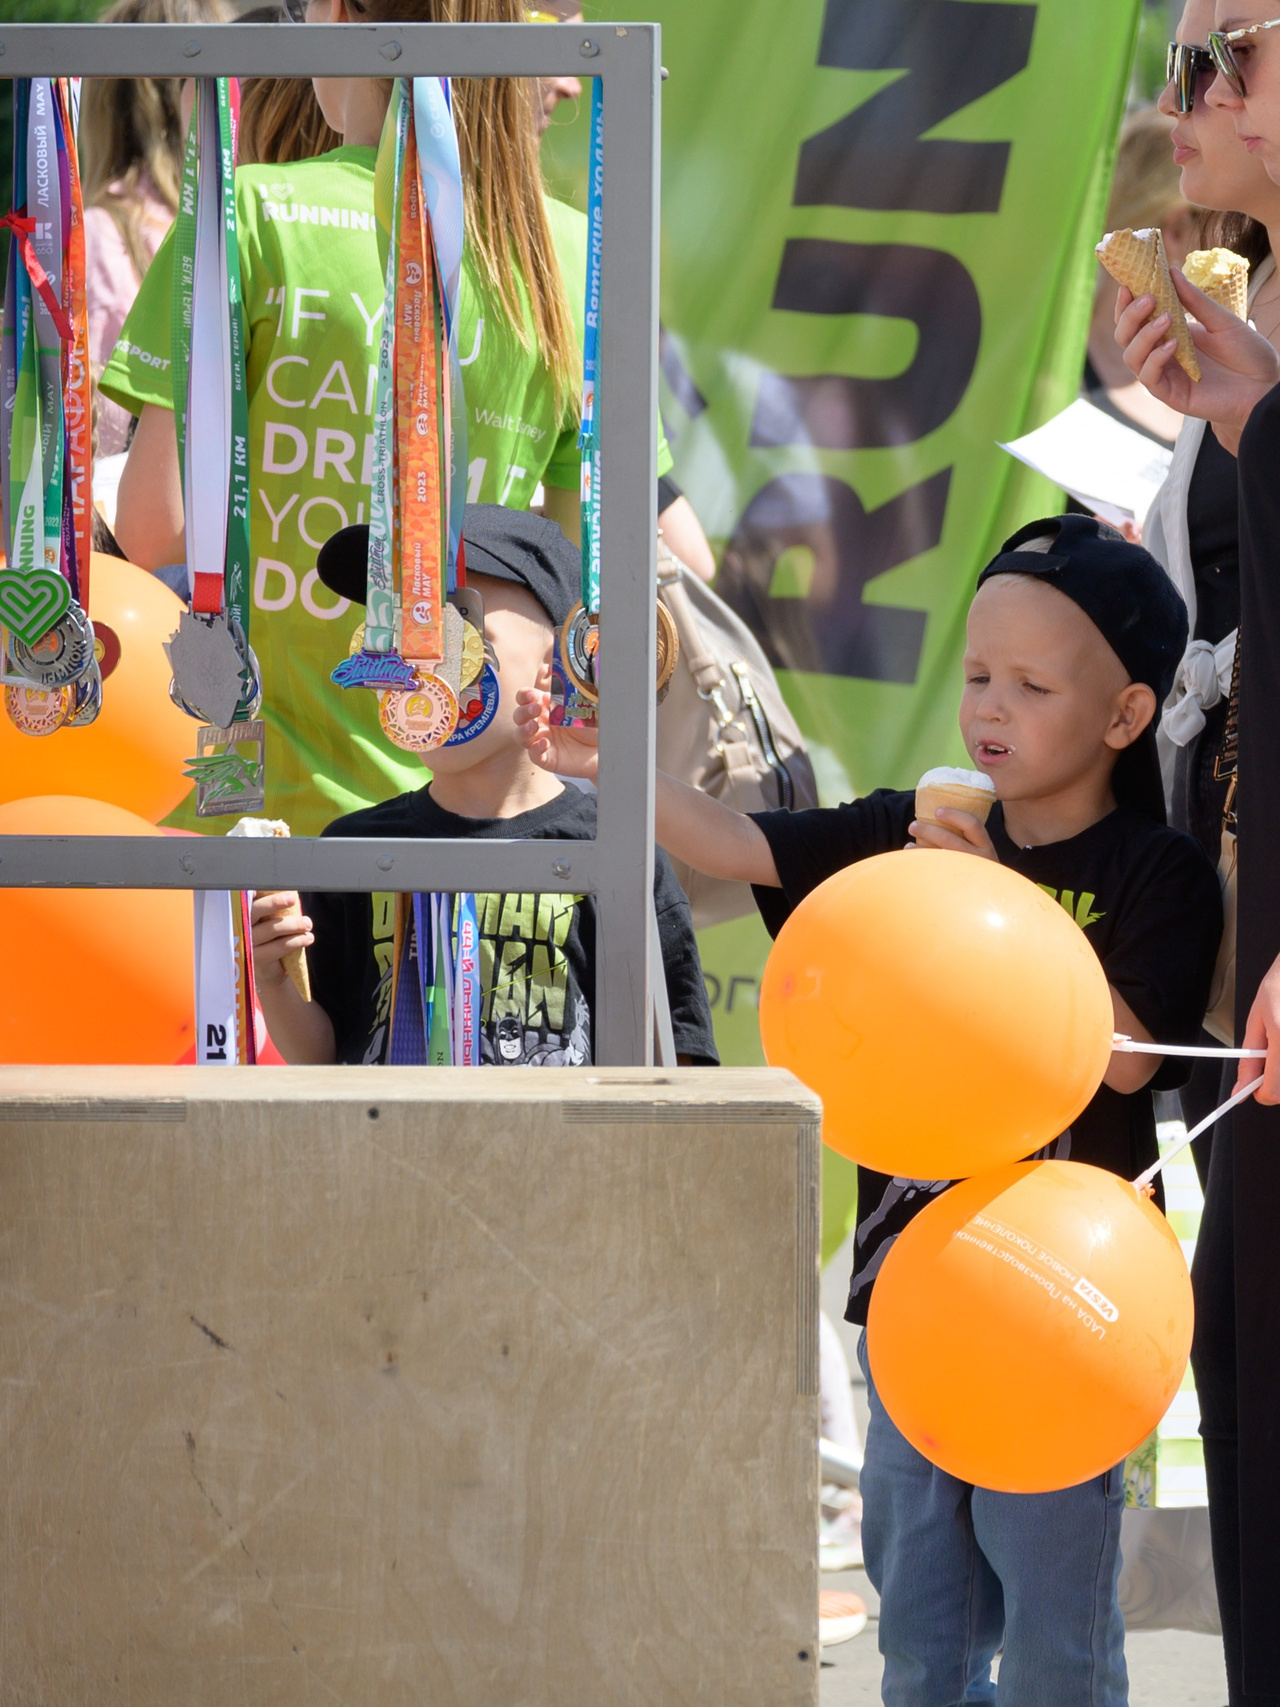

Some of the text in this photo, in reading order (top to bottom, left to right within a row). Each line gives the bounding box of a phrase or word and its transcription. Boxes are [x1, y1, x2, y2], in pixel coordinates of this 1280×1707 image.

[34, 84, 49, 208] ЛАСКОВЫЙ MAY
[223, 148, 235, 232] 21,1 КМ
[475, 407, 514, 432] Walt
[234, 435, 249, 519] 21,1 КМ
[377, 401, 387, 504] CROSS-TRIATHLON
[418, 471, 427, 503] 2023
[412, 542, 421, 596] Ласковый
[422, 573, 432, 598] MAY
[464, 692, 496, 738] КРЕМЛЕВА
[206, 1023, 227, 1061] 21
[462, 978, 472, 1066] ЛЫЖНЫ
[972, 1215, 1115, 1320] VESTA НОВОЕ ПОКОЛЕНИЕ
[1062, 1295, 1078, 1310] на
[1077, 1307, 1107, 1341] LADA
